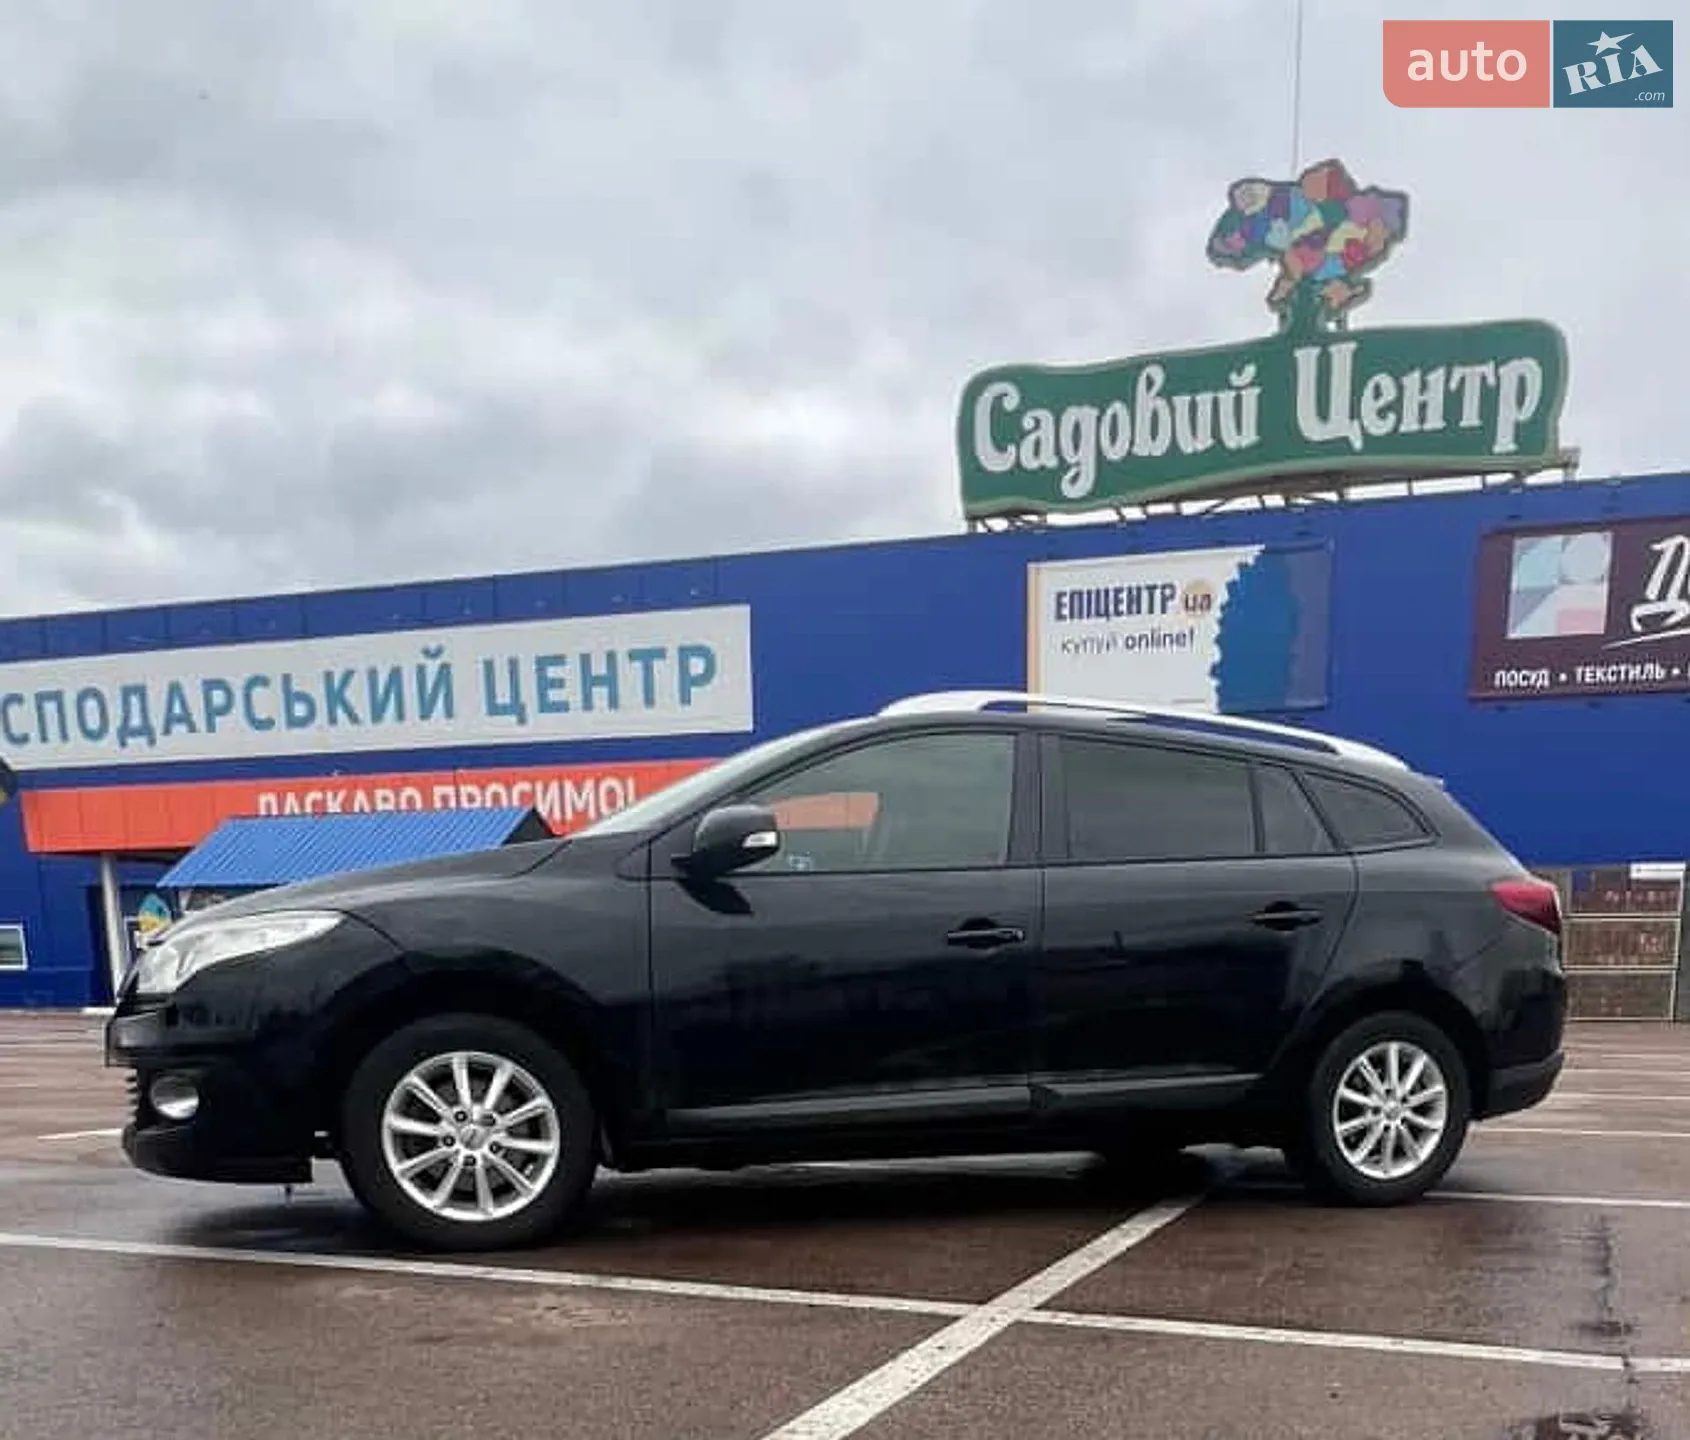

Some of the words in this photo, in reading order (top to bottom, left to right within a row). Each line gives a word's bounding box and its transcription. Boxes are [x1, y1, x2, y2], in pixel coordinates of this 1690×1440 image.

[973, 363, 1262, 499] Садовий
[1294, 341, 1544, 455] Центр
[1055, 582, 1177, 622] ЕПІЦЕНТР
[2, 646, 455, 749] СПОДАРСЬКИЙ
[483, 643, 717, 726] ЦЕНТР
[1575, 661, 1667, 685] ТЕКСТИЛЬ
